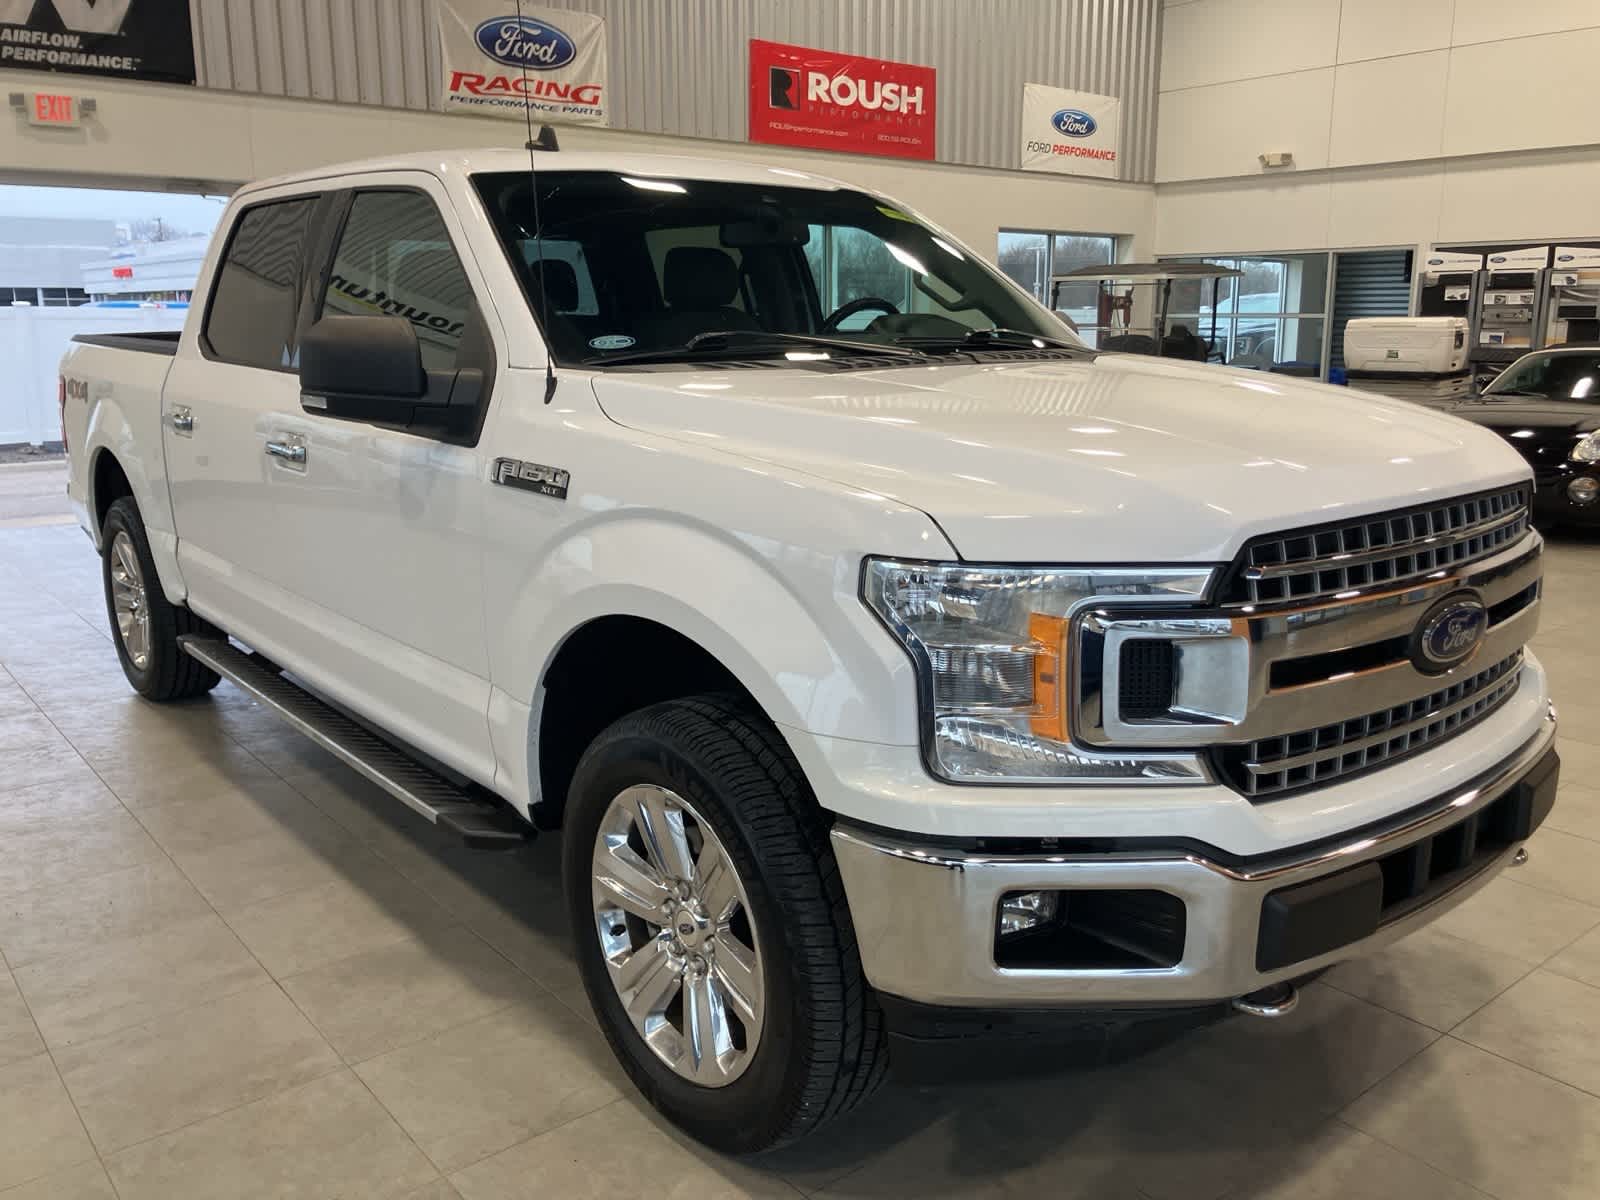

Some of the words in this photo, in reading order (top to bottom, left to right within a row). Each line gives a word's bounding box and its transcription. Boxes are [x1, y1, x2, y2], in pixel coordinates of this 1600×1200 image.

[0, 28, 84, 49] AIRFLOW.
[494, 22, 558, 64] Ford
[449, 71, 603, 105] RACING
[807, 70, 924, 115] ROUSH
[35, 93, 74, 122] EXIT
[450, 95, 557, 113] PERFORMANCE
[562, 106, 603, 116] PARTS
[1060, 113, 1088, 133] Ford
[1027, 141, 1051, 154] FORD
[1052, 144, 1117, 161] PERFORMANCE
[541, 485, 557, 495] XLT
